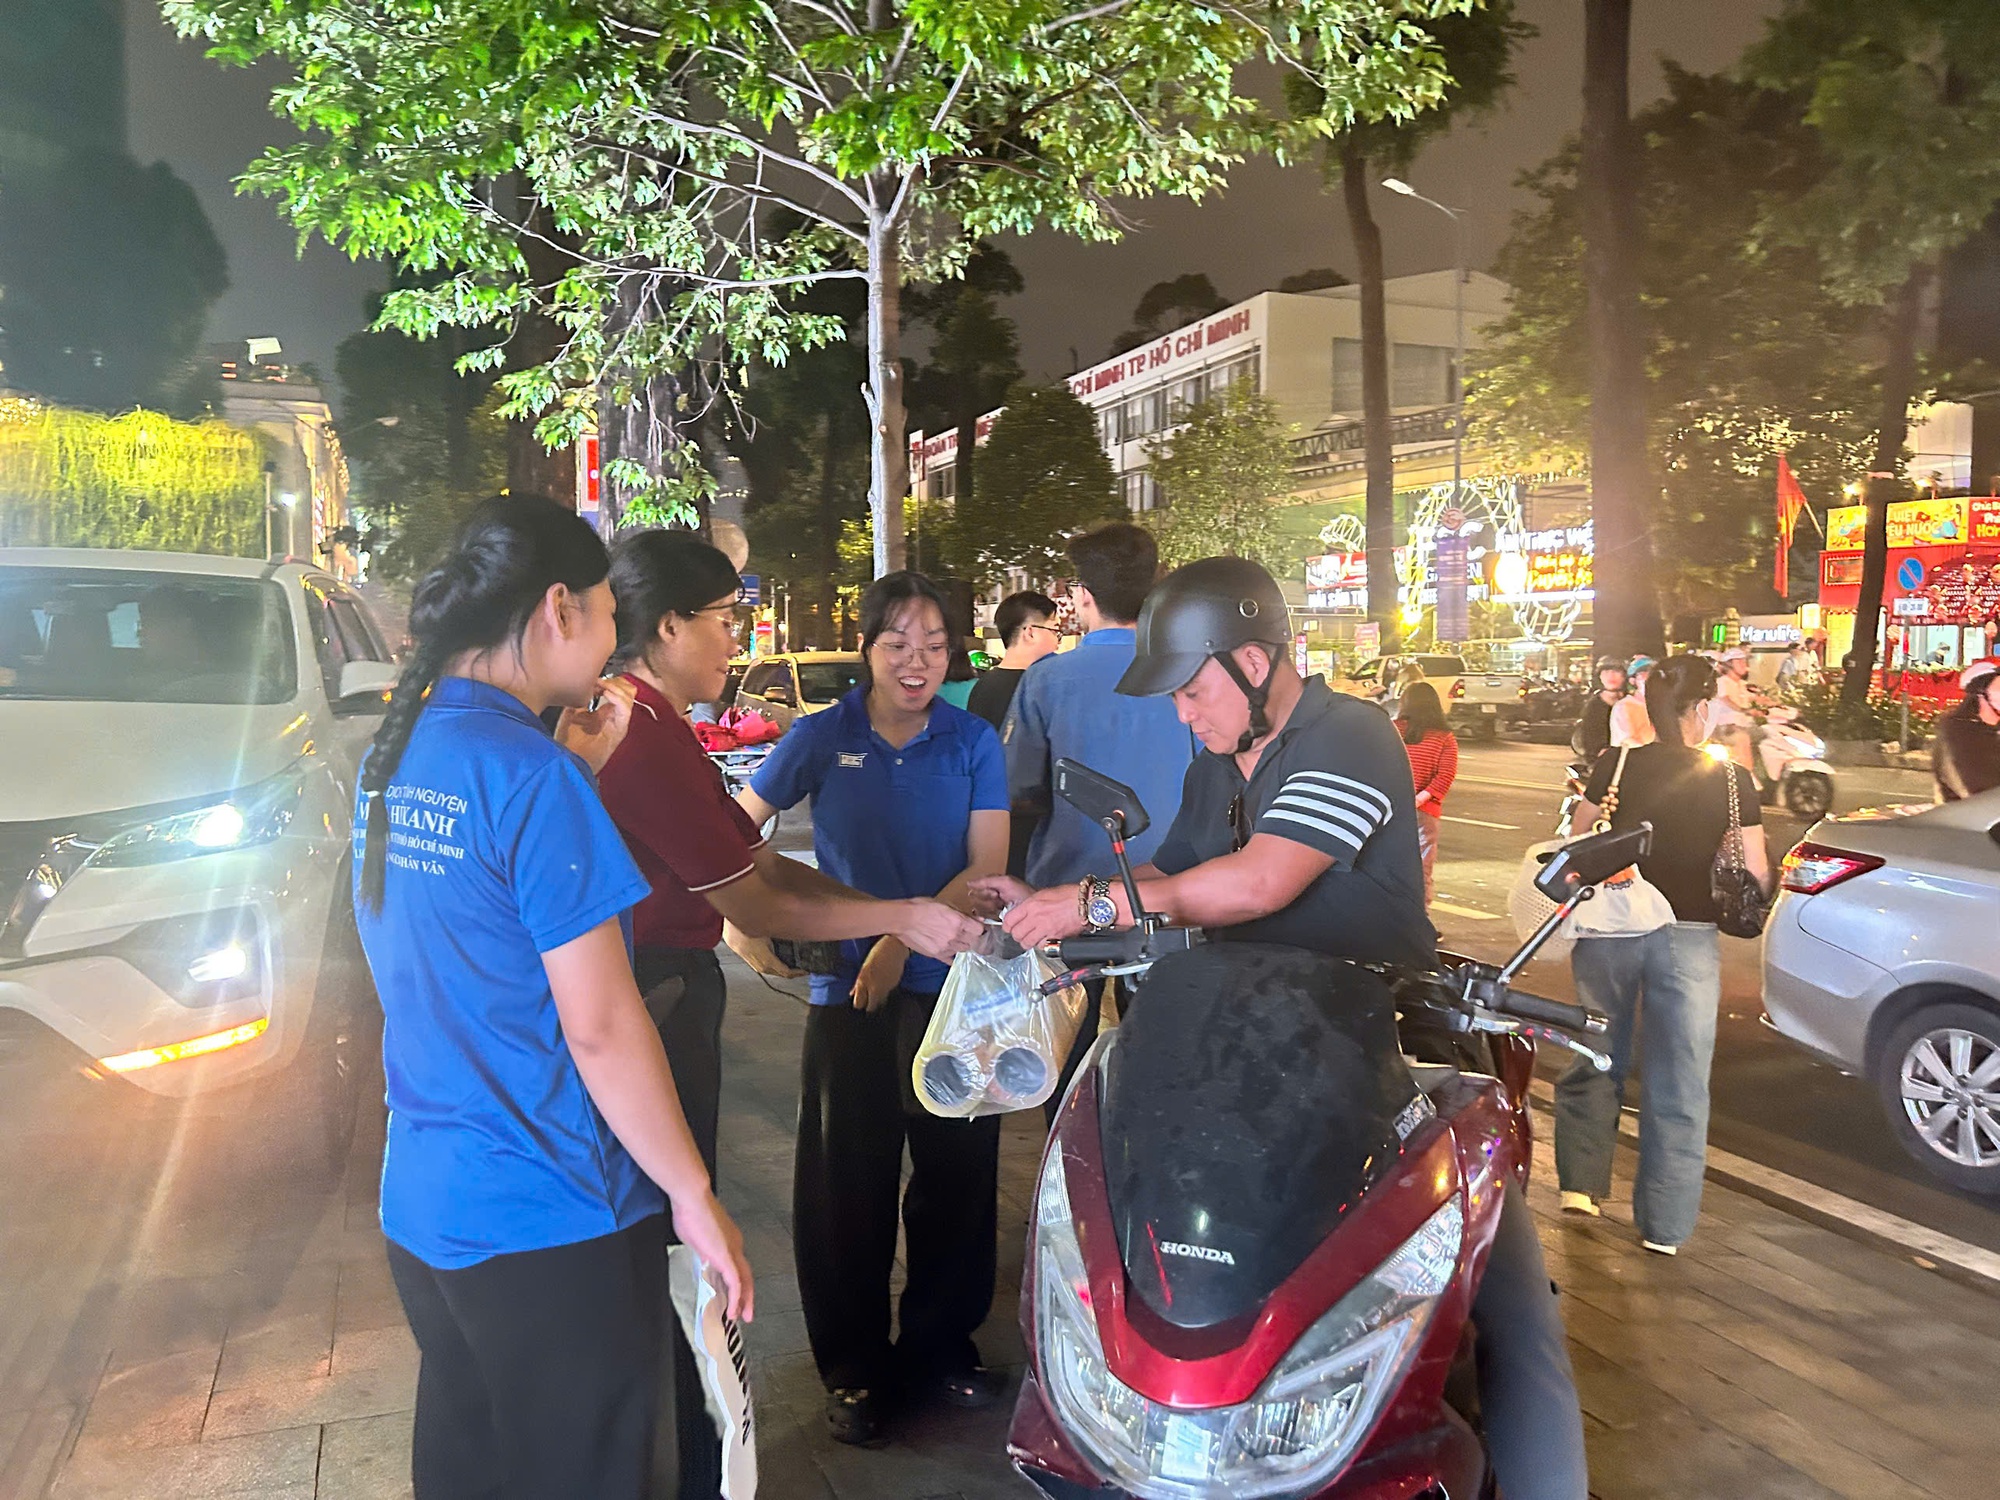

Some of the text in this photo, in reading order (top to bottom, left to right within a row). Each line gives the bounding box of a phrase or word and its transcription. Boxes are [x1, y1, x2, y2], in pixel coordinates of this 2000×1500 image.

[1094, 362, 1125, 391] MINH
[1176, 323, 1203, 358] CHÍ
[1207, 309, 1250, 346] MINH
[1740, 624, 1800, 642] Manulife
[414, 787, 467, 814] NGUYỆN
[1160, 1241, 1235, 1265] HONDA
